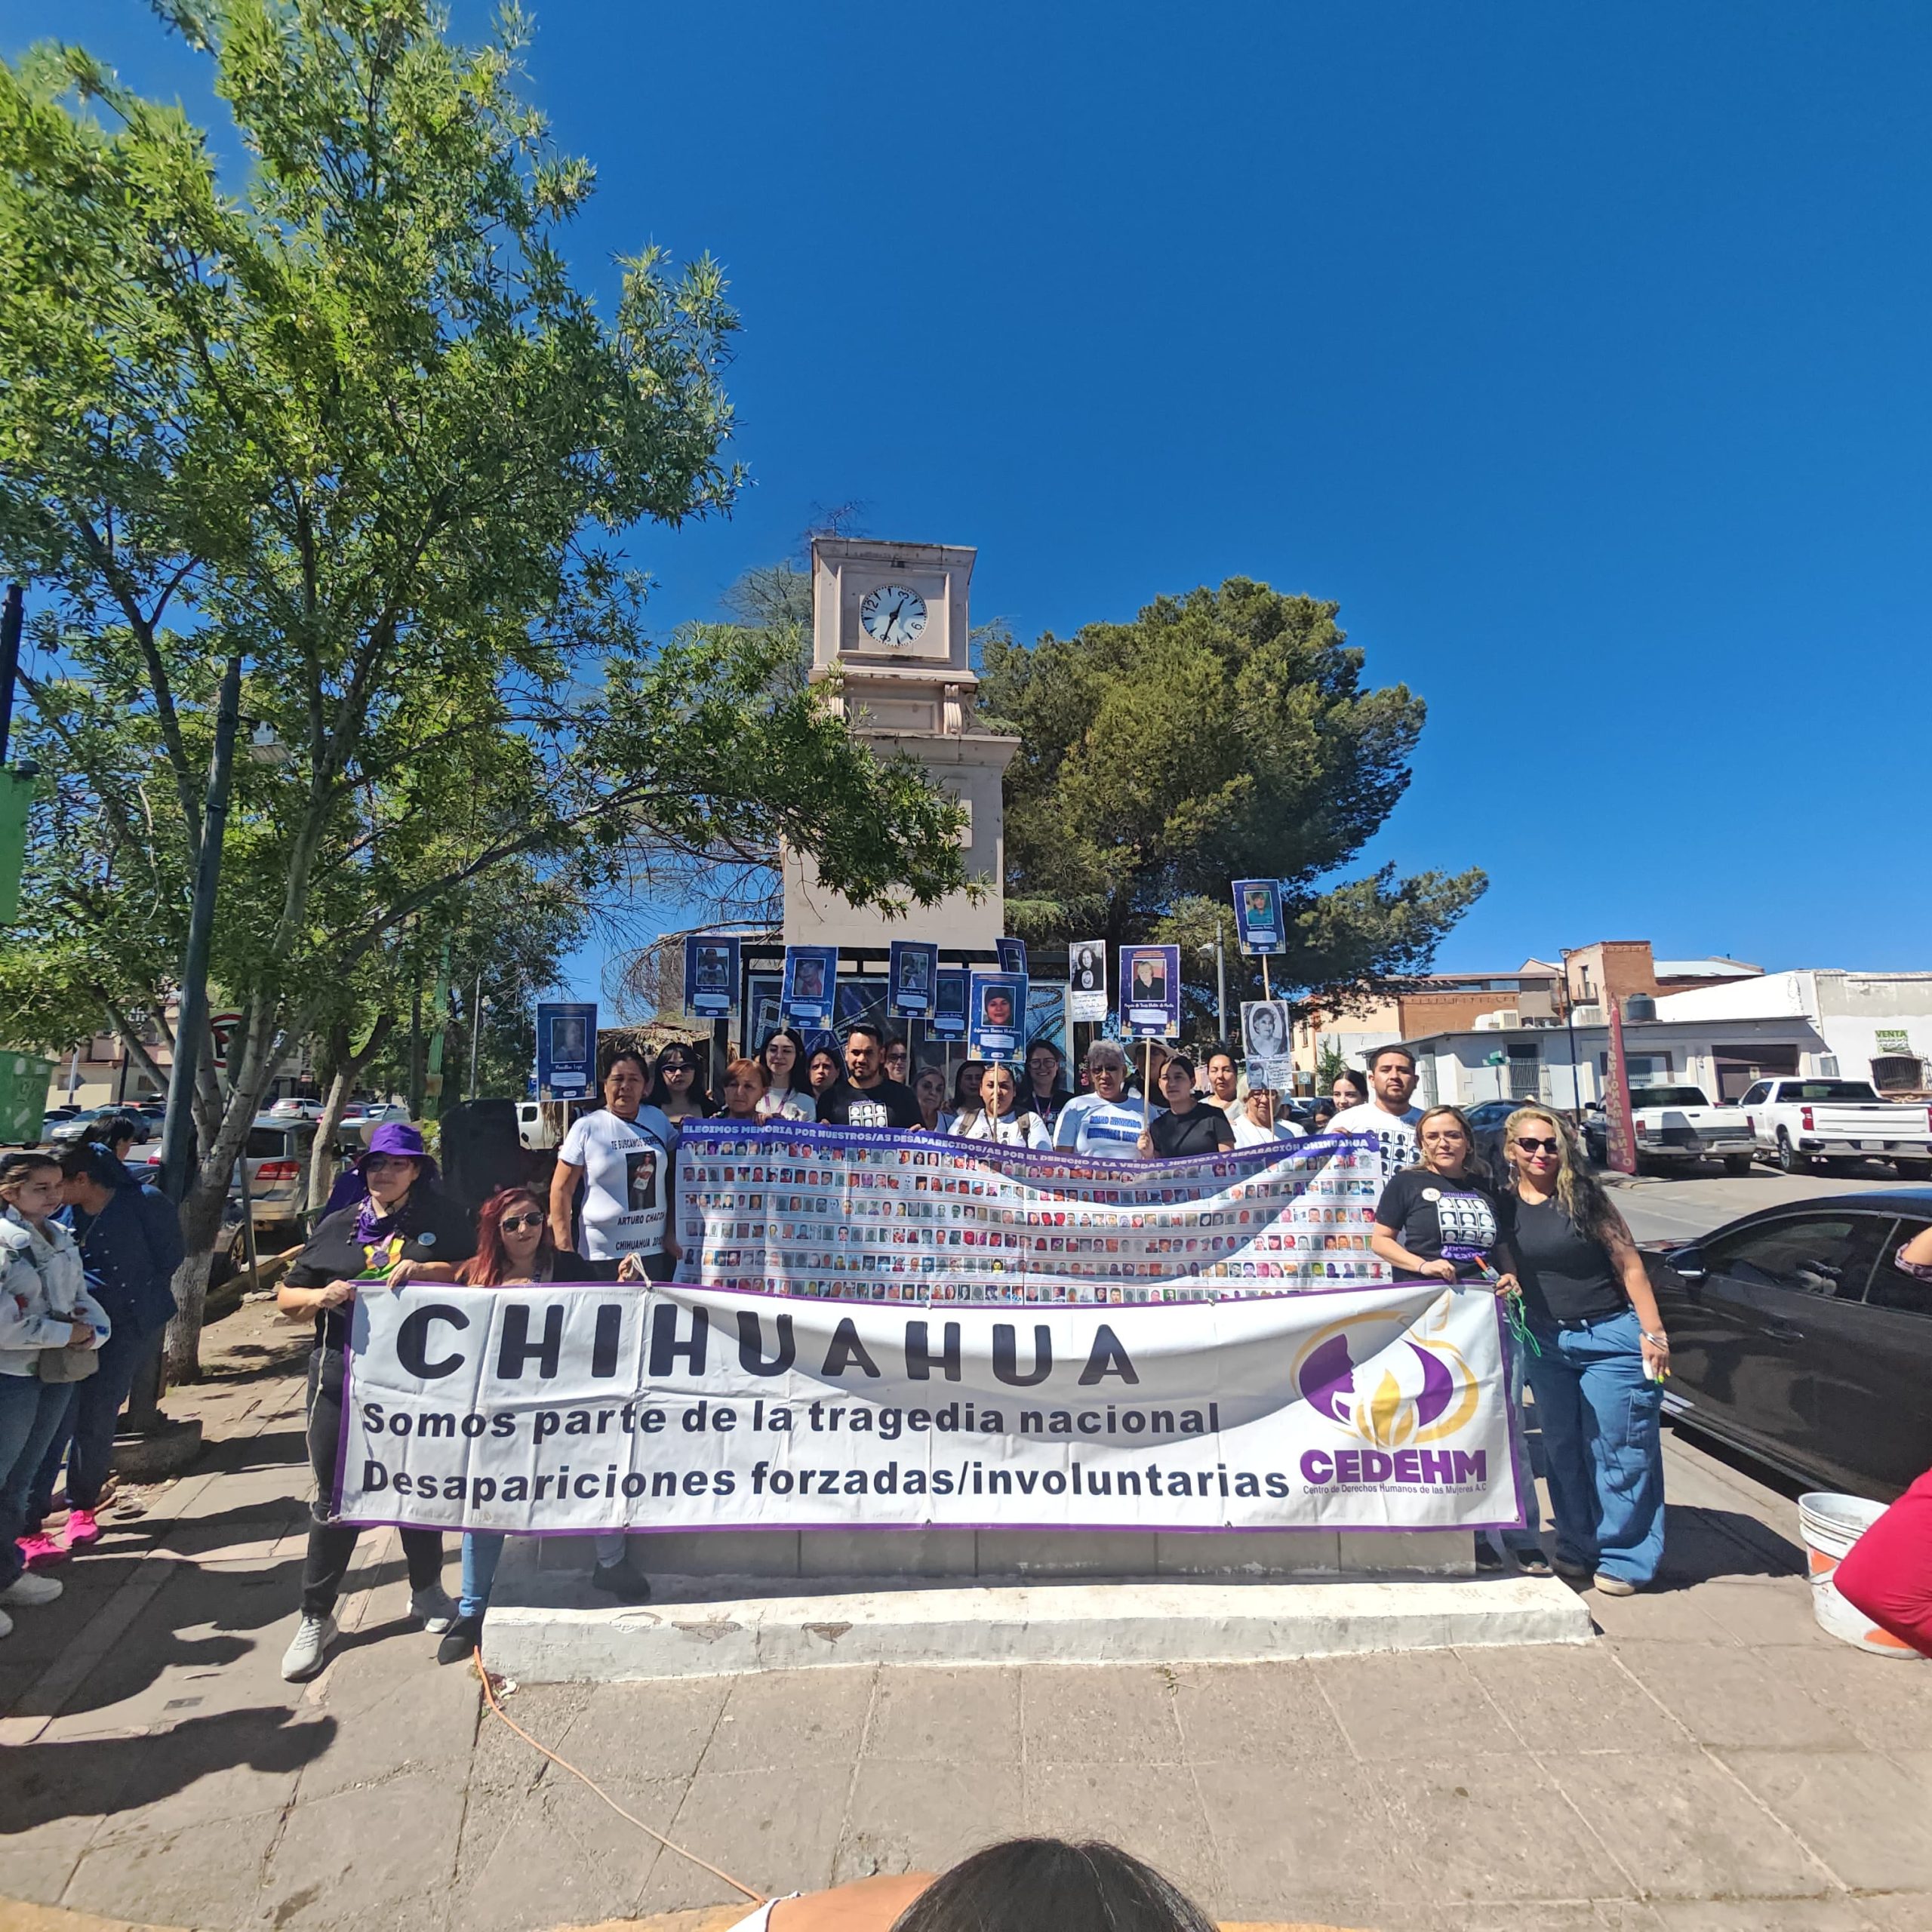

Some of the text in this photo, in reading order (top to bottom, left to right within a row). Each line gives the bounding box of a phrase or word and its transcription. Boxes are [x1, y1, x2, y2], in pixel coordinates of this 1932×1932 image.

[898, 590, 909, 599] 3
[862, 599, 879, 612] 12
[611, 1140, 617, 1150] TE
[618, 1137, 642, 1149] BUSCAMOS
[683, 1124, 739, 1134] ELEGIMOS
[742, 1125, 792, 1135] MEMORIA
[795, 1128, 816, 1137] POR
[818, 1129, 891, 1143] NUESTROS/AS
[894, 1134, 1001, 1155] DESAPARECIDOS/AS
[1003, 1149, 1025, 1159] POR
[1026, 1152, 1038, 1161] EL
[1040, 1155, 1090, 1166] DERECHO
[1231, 1141, 1300, 1158] REPARACIÓN
[1303, 1138, 1369, 1151] CHIHUAHUA
[617, 1215, 644, 1226] ARTURO
[615, 1238, 650, 1251] CHIHUAHUA
[396, 1303, 1140, 1387] CHIHUAHUA
[362, 1400, 1220, 1445] Somos parte de la tragedia nacional
[1300, 1449, 1487, 1484] CEDEHM
[361, 1460, 1289, 1509] Desapariciones forzadas/involuntarias
[1303, 1484, 1329, 1494] Centro
[1331, 1485, 1340, 1494] de
[1342, 1484, 1377, 1493] Derechos
[1380, 1484, 1417, 1494] Humanos
[1420, 1485, 1430, 1494] de
[1432, 1484, 1444, 1494] las
[1445, 1484, 1473, 1496] Mujeres
